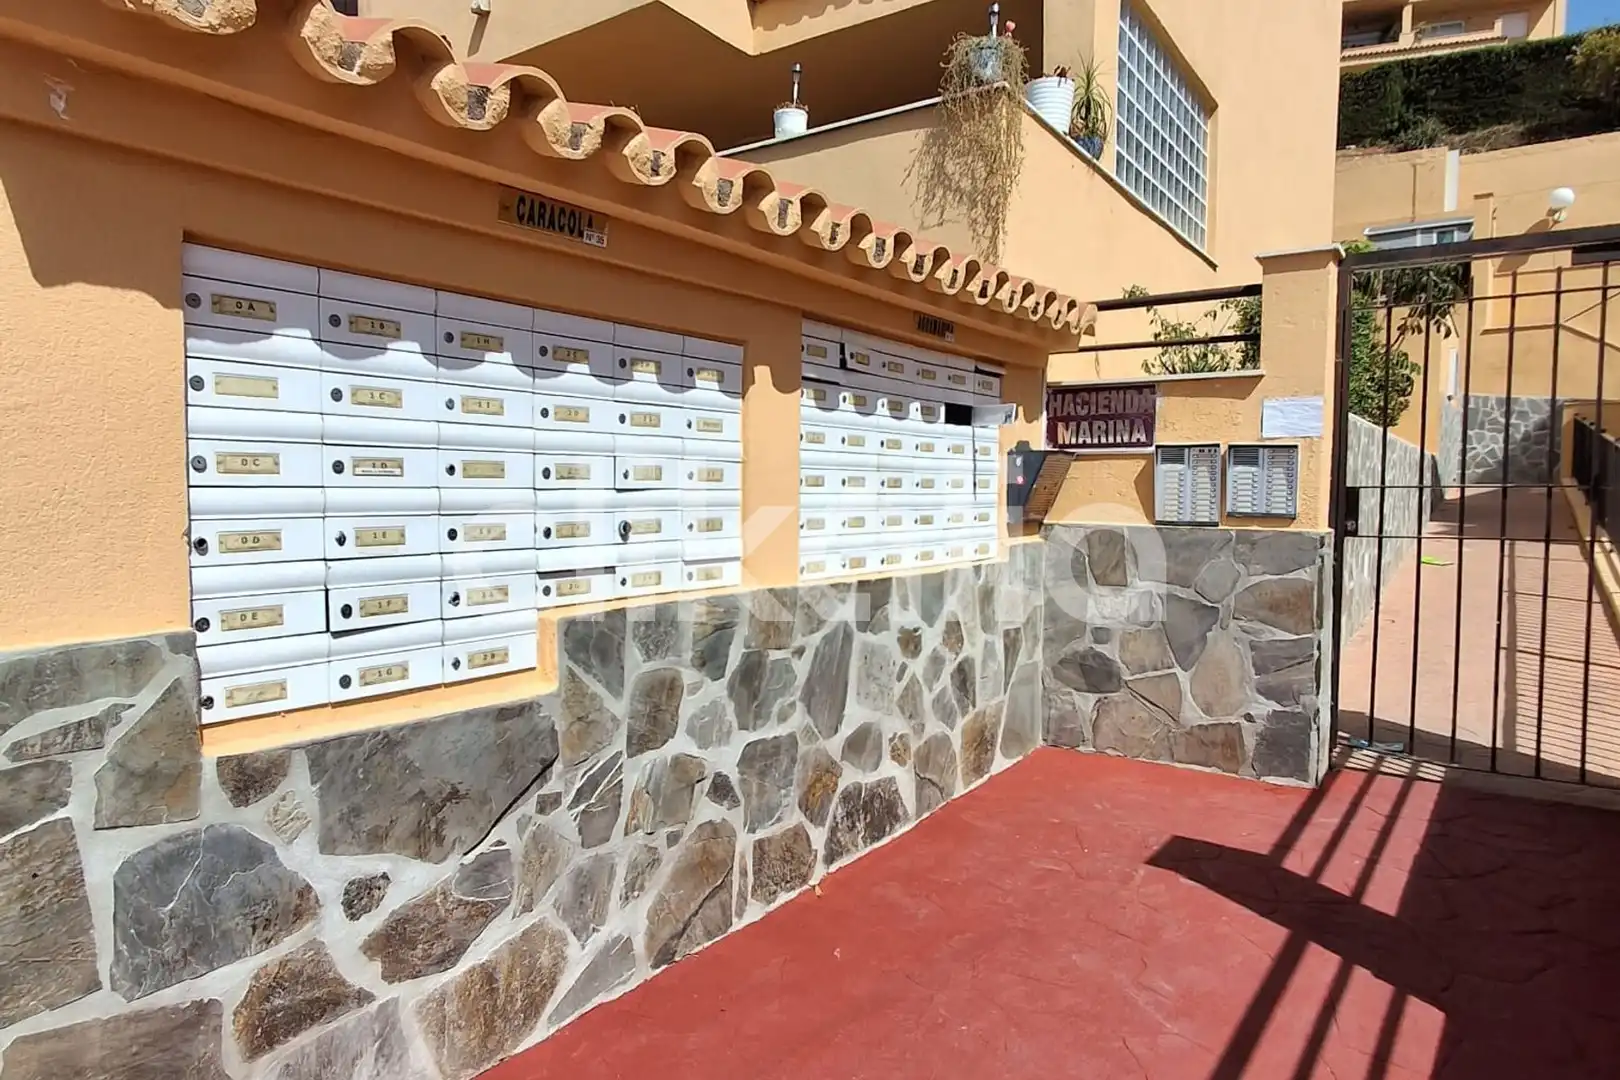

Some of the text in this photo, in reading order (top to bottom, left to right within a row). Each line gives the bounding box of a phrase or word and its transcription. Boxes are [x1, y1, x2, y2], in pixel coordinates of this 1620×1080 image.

[516, 194, 594, 238] CARACOLA
[1048, 388, 1154, 417] HACIENDA
[1057, 419, 1147, 444] MARINA
